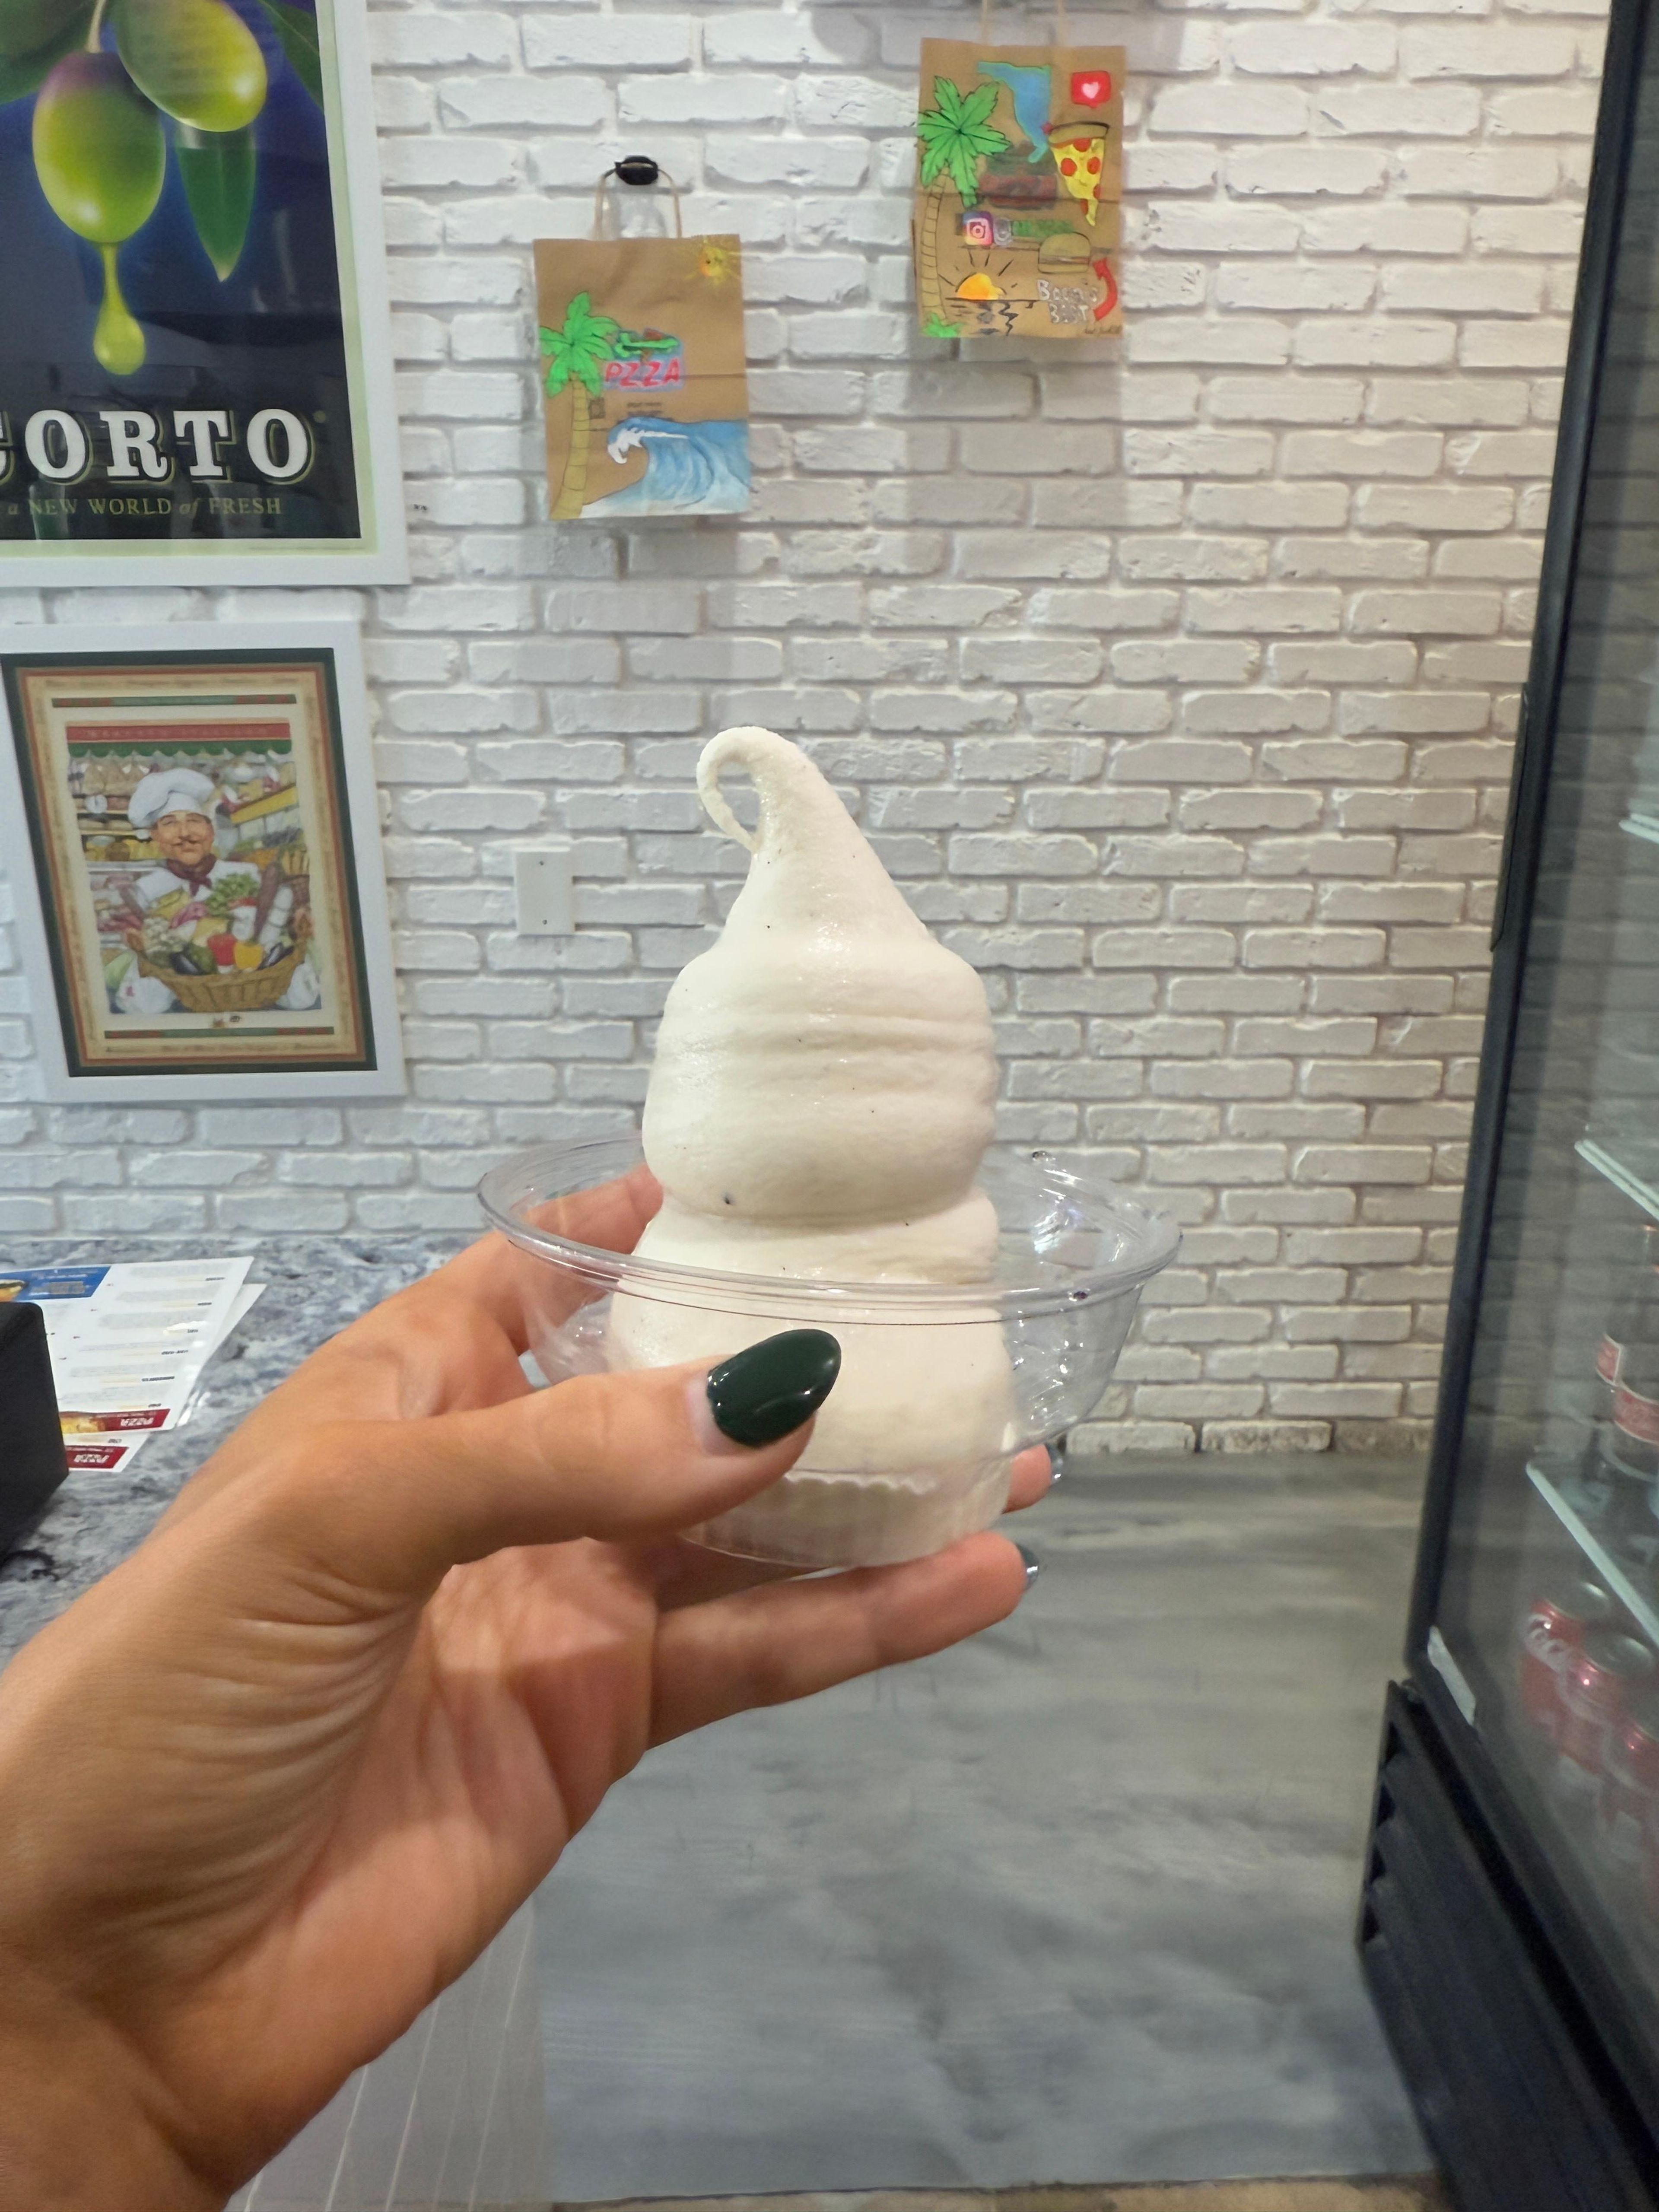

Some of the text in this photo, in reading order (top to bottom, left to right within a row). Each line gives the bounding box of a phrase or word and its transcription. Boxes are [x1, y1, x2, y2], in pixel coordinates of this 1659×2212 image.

[0, 409, 315, 484] ORTO
[29, 499, 77, 515] NEW
[88, 498, 172, 515] WORLD
[179, 498, 201, 515] of
[209, 497, 281, 515] FRESH
